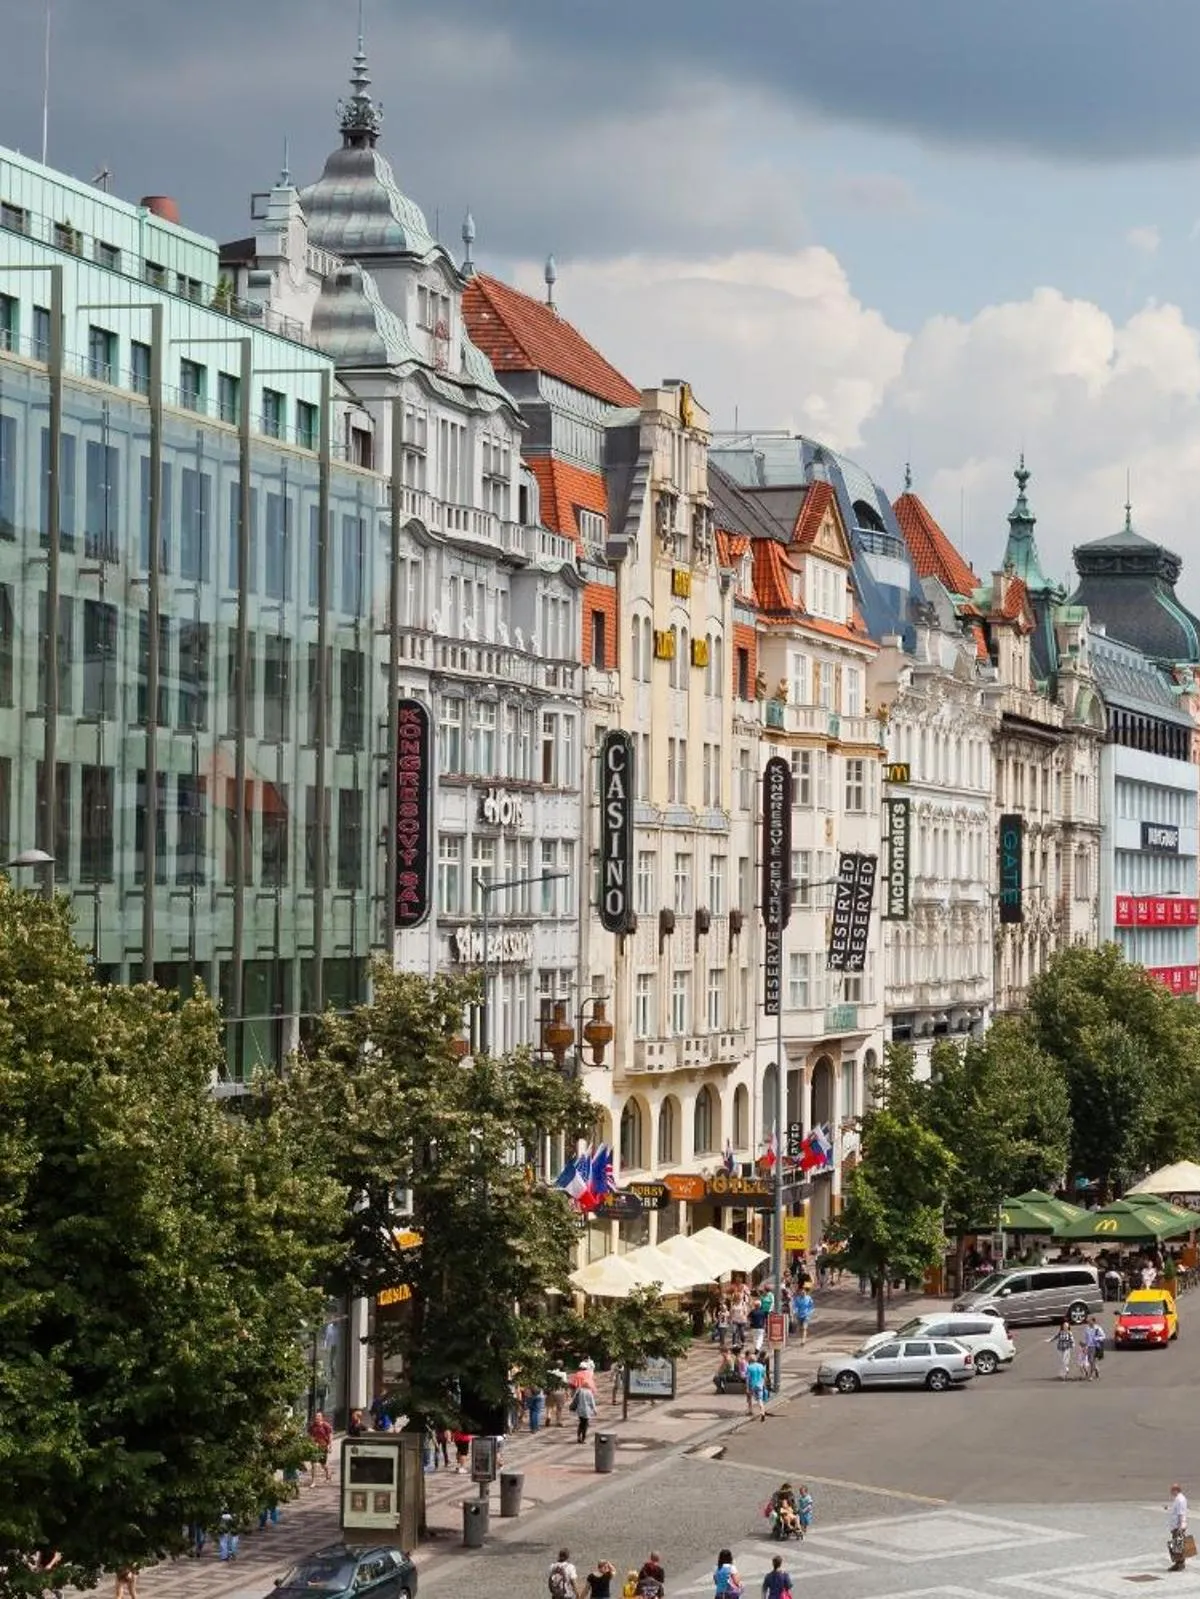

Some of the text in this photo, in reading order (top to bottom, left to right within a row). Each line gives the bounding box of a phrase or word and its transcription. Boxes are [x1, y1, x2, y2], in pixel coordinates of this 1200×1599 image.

[606, 744, 626, 916] CASINO
[891, 803, 907, 915] McDonald's
[1003, 831, 1018, 904] GATE
[830, 859, 855, 965] RESERVED
[850, 861, 875, 969] RESERVED
[767, 931, 780, 1013] RESERVE
